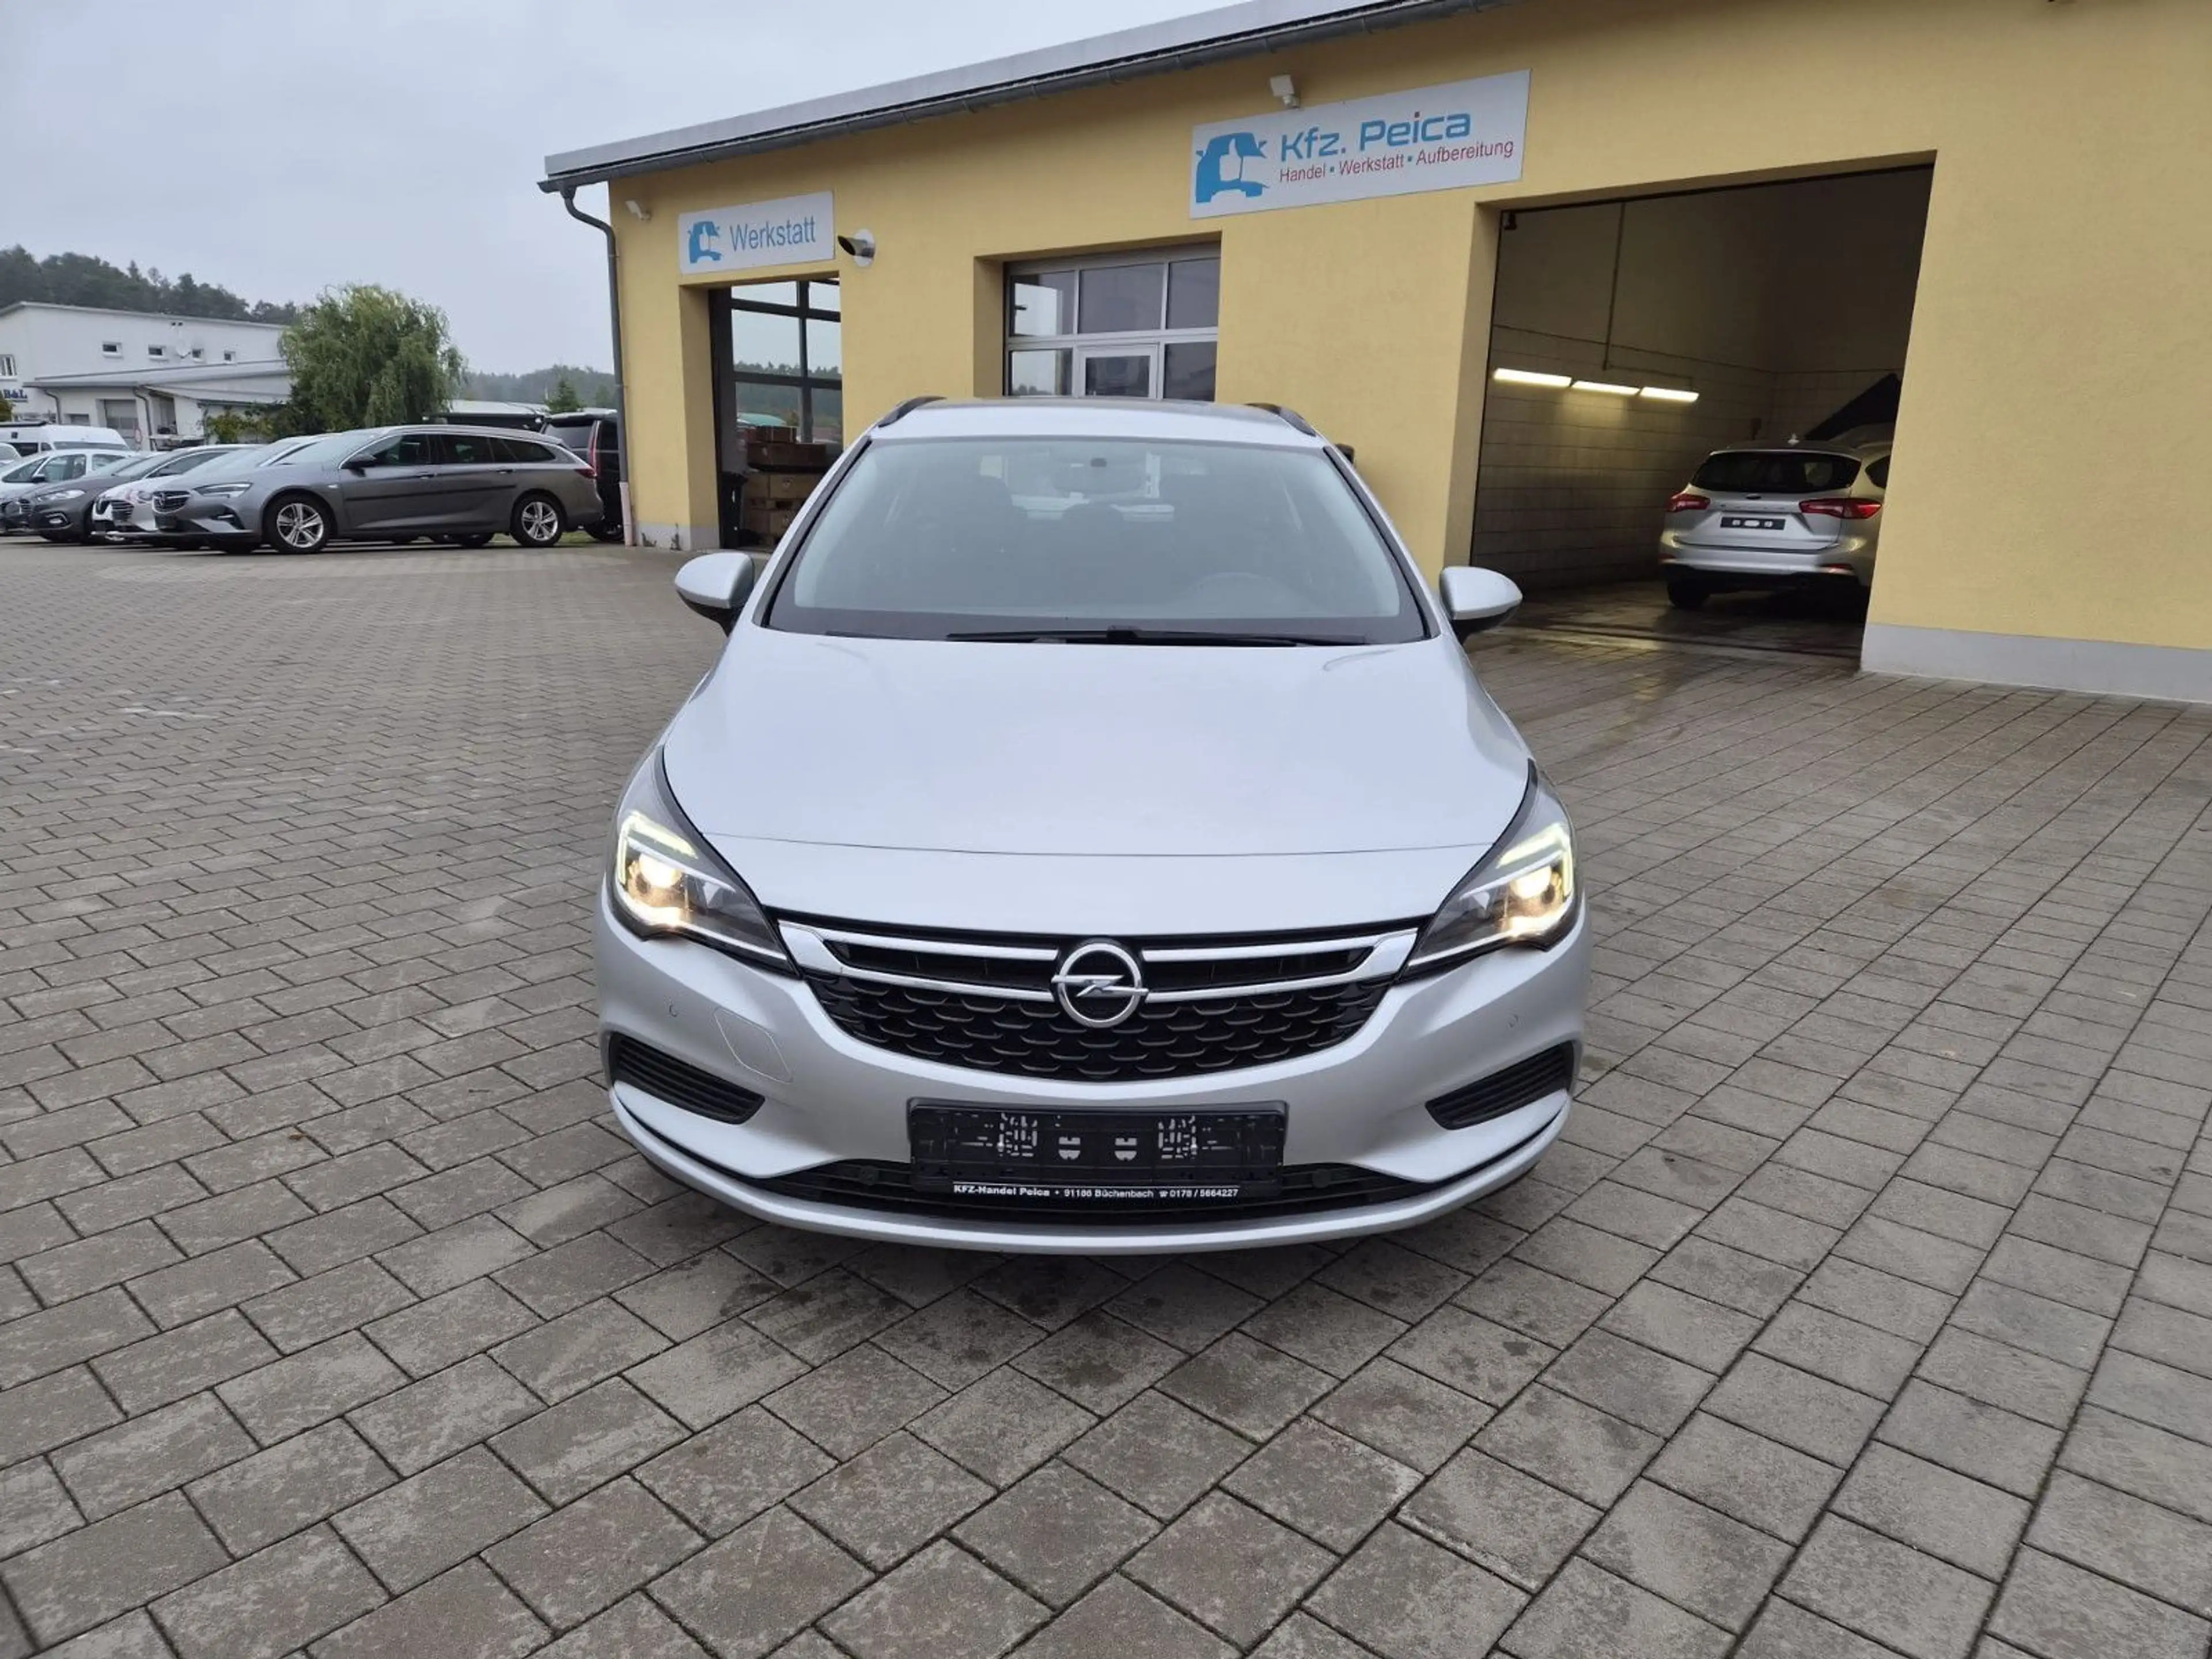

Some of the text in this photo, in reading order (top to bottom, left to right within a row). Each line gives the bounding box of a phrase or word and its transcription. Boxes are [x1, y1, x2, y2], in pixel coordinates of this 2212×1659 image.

[1281, 111, 1471, 162] Kfz. Peica
[1279, 139, 1514, 183] Handel Werkstatt Aufbereitung
[729, 215, 816, 252] Werkstatt
[953, 1184, 1017, 1195] KFZ-Handel
[1094, 1188, 1154, 1198] Büchenbach
